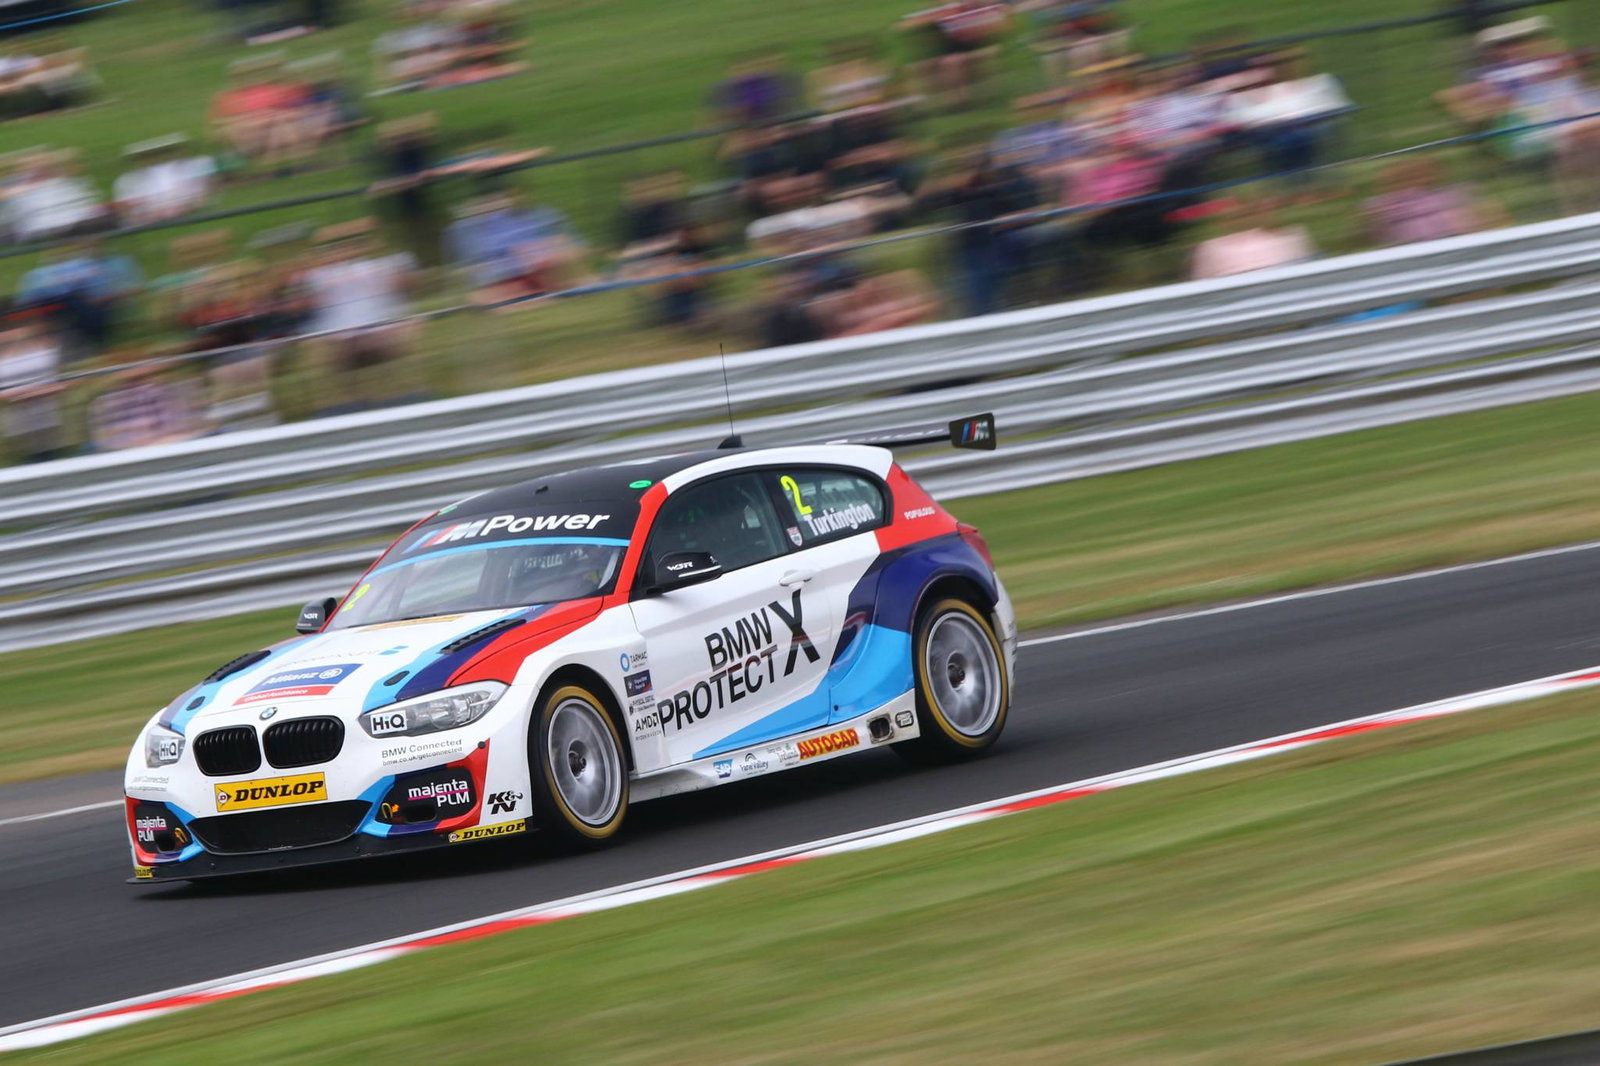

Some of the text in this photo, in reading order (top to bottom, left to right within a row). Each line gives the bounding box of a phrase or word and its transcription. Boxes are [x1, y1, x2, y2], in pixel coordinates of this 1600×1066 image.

[780, 475, 813, 515] 2
[803, 503, 876, 537] Turkington
[705, 607, 773, 673] BMW
[768, 588, 821, 677] X
[657, 644, 778, 737] PROTECT
[372, 713, 406, 731] HiQ
[635, 715, 653, 732] AMD
[160, 741, 177, 757] HiQ
[381, 739, 463, 759] BMW Connected
[797, 727, 860, 760] AUTOCAR
[234, 780, 324, 803] DUNLOP
[407, 778, 468, 799] majenta
[436, 792, 470, 807] PLM
[462, 822, 525, 839] DUNLOP
